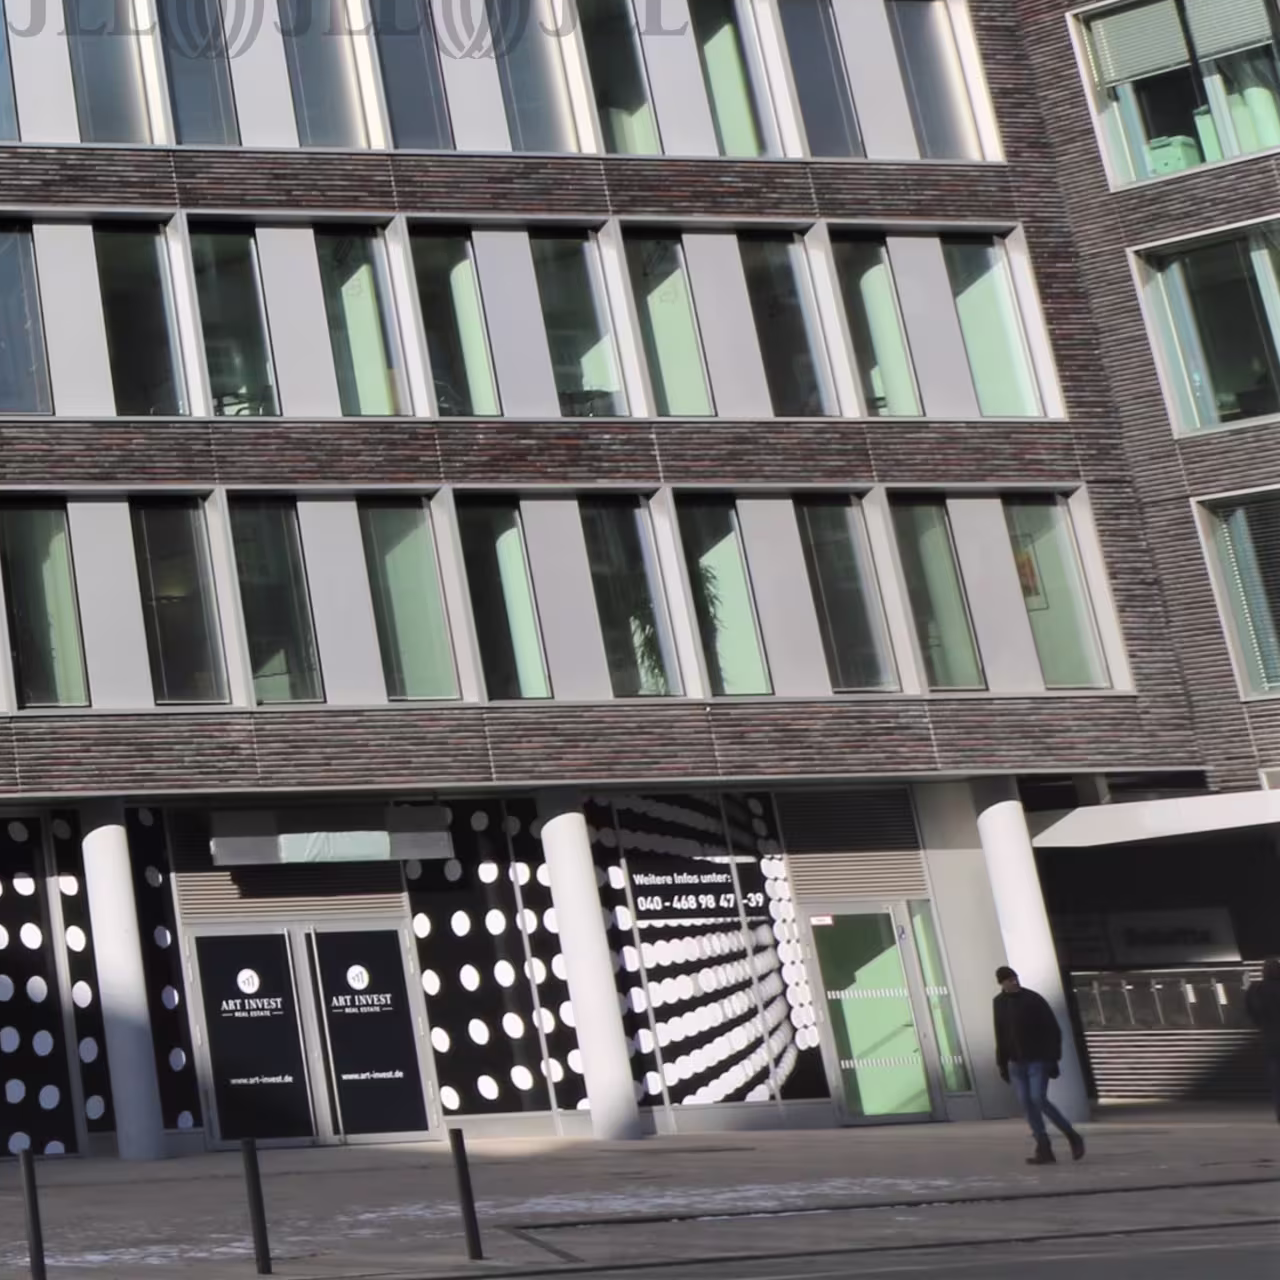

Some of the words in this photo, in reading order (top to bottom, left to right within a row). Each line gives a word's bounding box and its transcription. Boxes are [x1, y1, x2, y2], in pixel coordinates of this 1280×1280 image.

[633, 874, 673, 886] Weitere
[674, 872, 699, 885] Infos
[700, 872, 732, 884] unter:
[637, 896, 663, 911] 040
[672, 894, 697, 910] 468
[698, 893, 716, 909] 98
[221, 999, 242, 1011] ART
[244, 997, 282, 1010] INVEST
[331, 995, 354, 1007] ART
[354, 993, 392, 1006] INVEST
